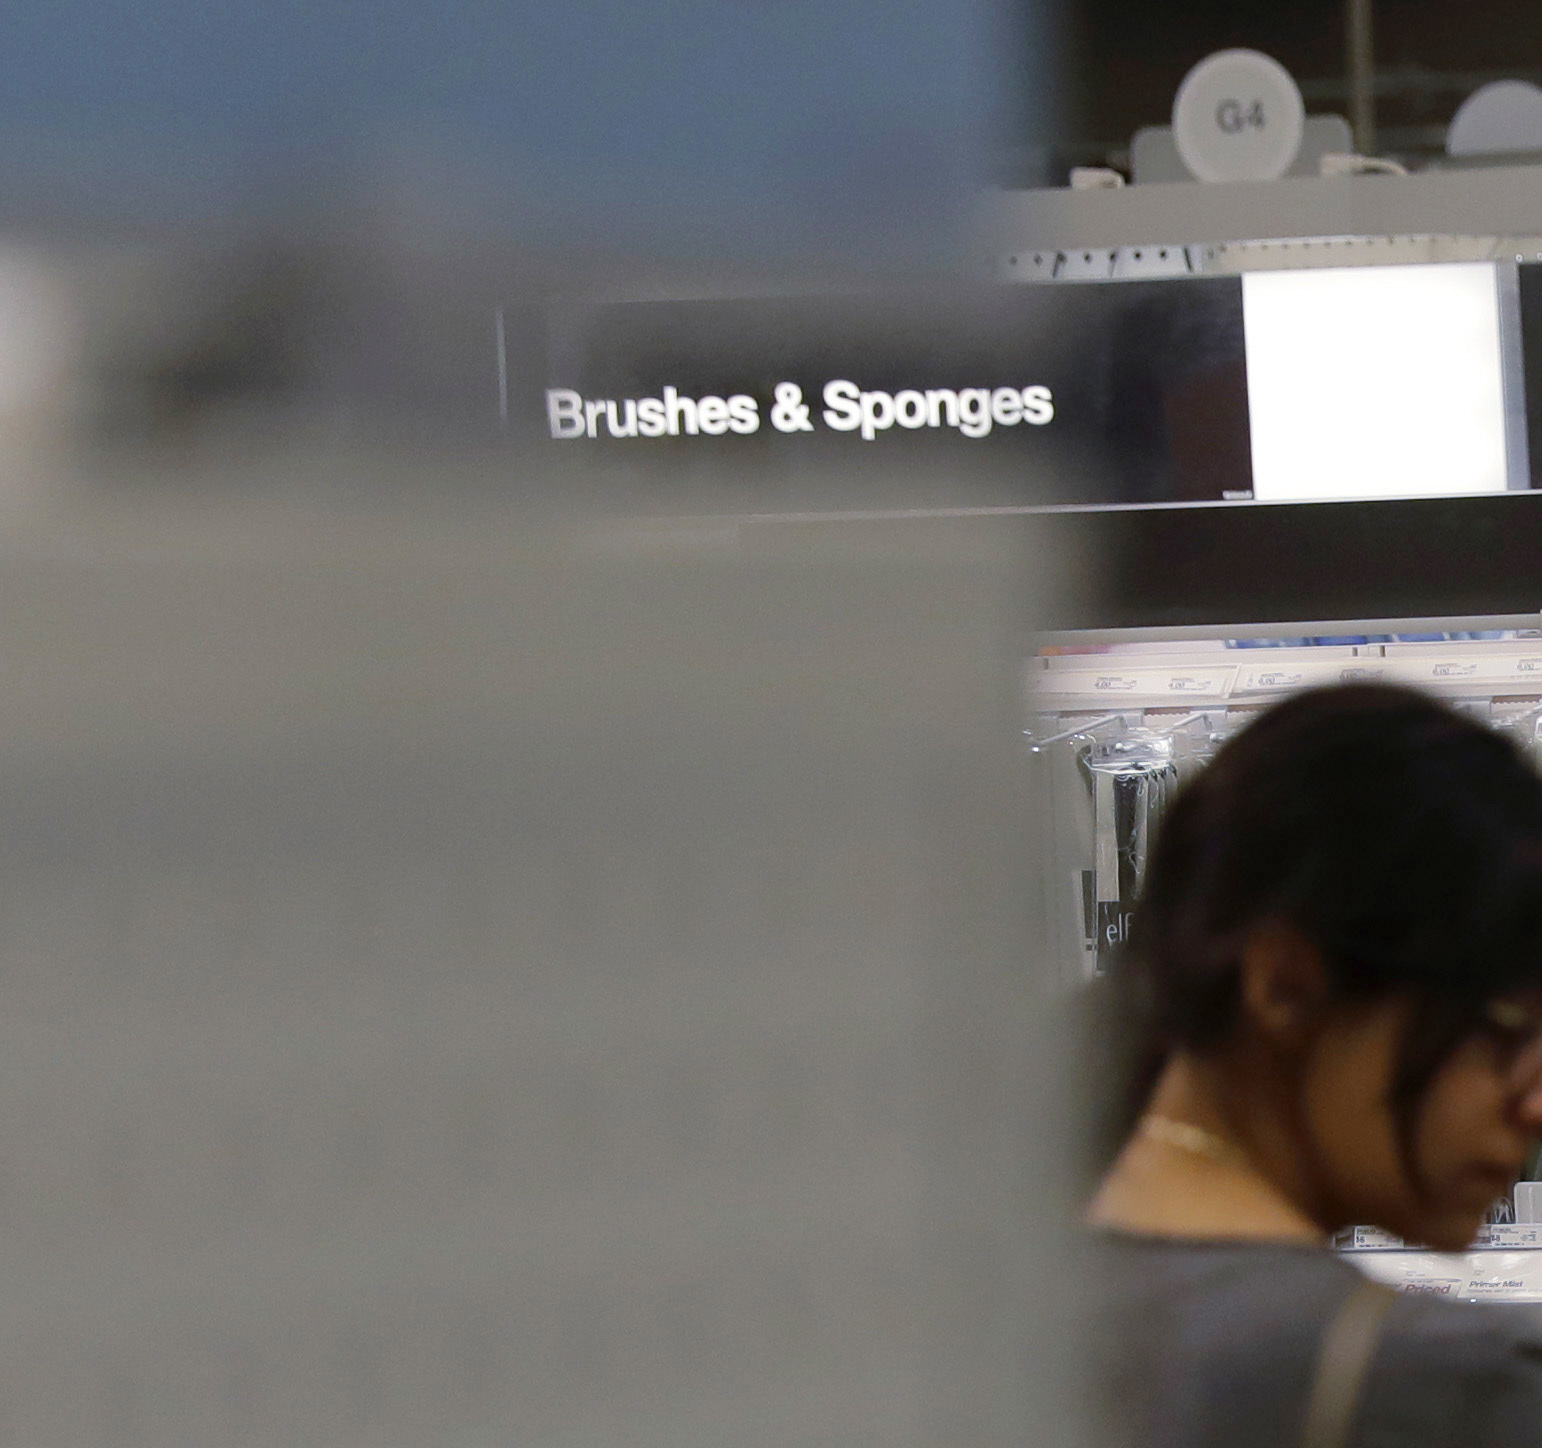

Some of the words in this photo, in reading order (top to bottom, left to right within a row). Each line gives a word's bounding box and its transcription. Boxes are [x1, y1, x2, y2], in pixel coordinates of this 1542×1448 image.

[1216, 98, 1266, 135] G4
[548, 386, 759, 440] Brushes
[771, 381, 814, 432] &
[822, 380, 1054, 440] Sponges
[1502, 1280, 1524, 1288] Mist
